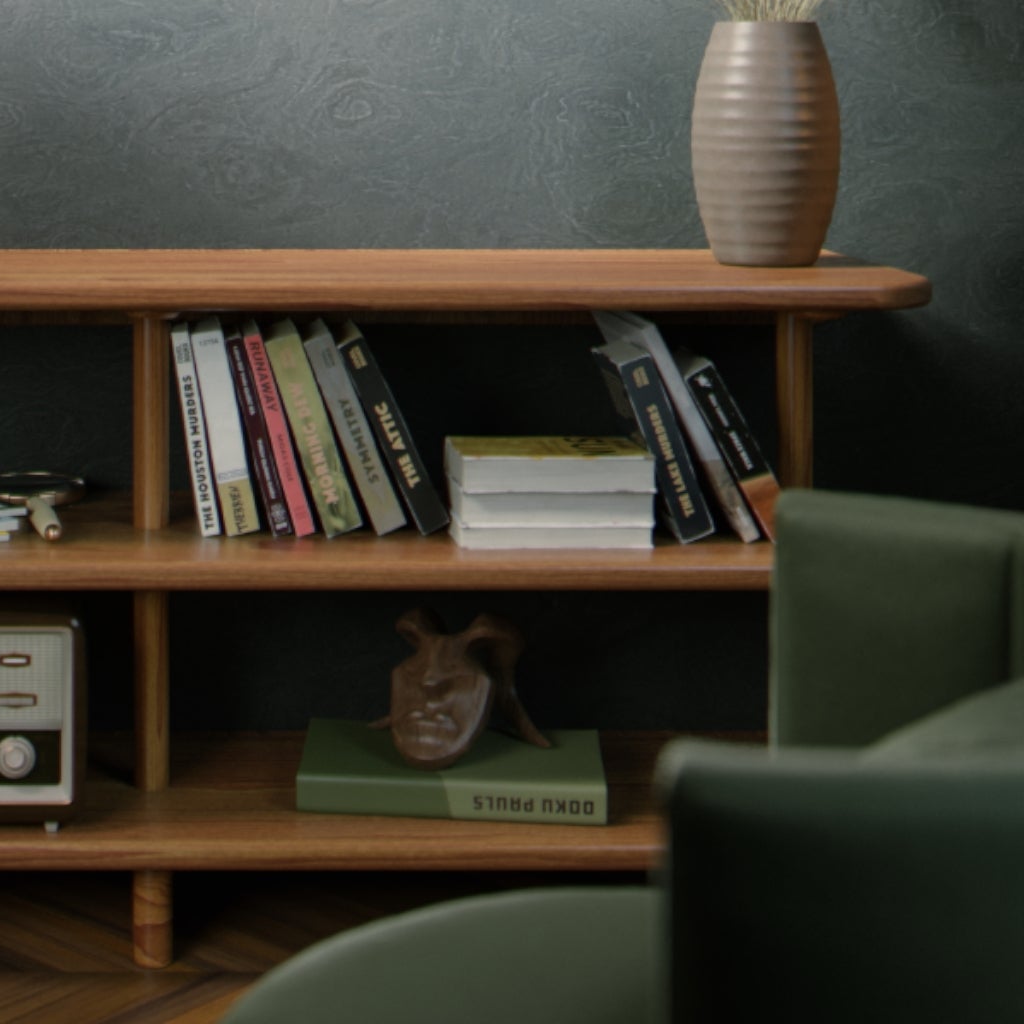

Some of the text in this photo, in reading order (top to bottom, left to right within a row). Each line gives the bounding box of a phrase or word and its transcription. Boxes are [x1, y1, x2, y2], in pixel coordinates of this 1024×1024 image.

[249, 341, 278, 412] RUNAWAY
[181, 375, 215, 530] THE HOUSTON MURDERS
[302, 418, 339, 505] MORNING
[339, 398, 379, 484] SYMMETRY
[374, 401, 421, 489] THE ATTIC
[646, 404, 676, 463] MURDERS
[678, 493, 695, 519] THE
[473, 795, 594, 815] DOKU PAULS
